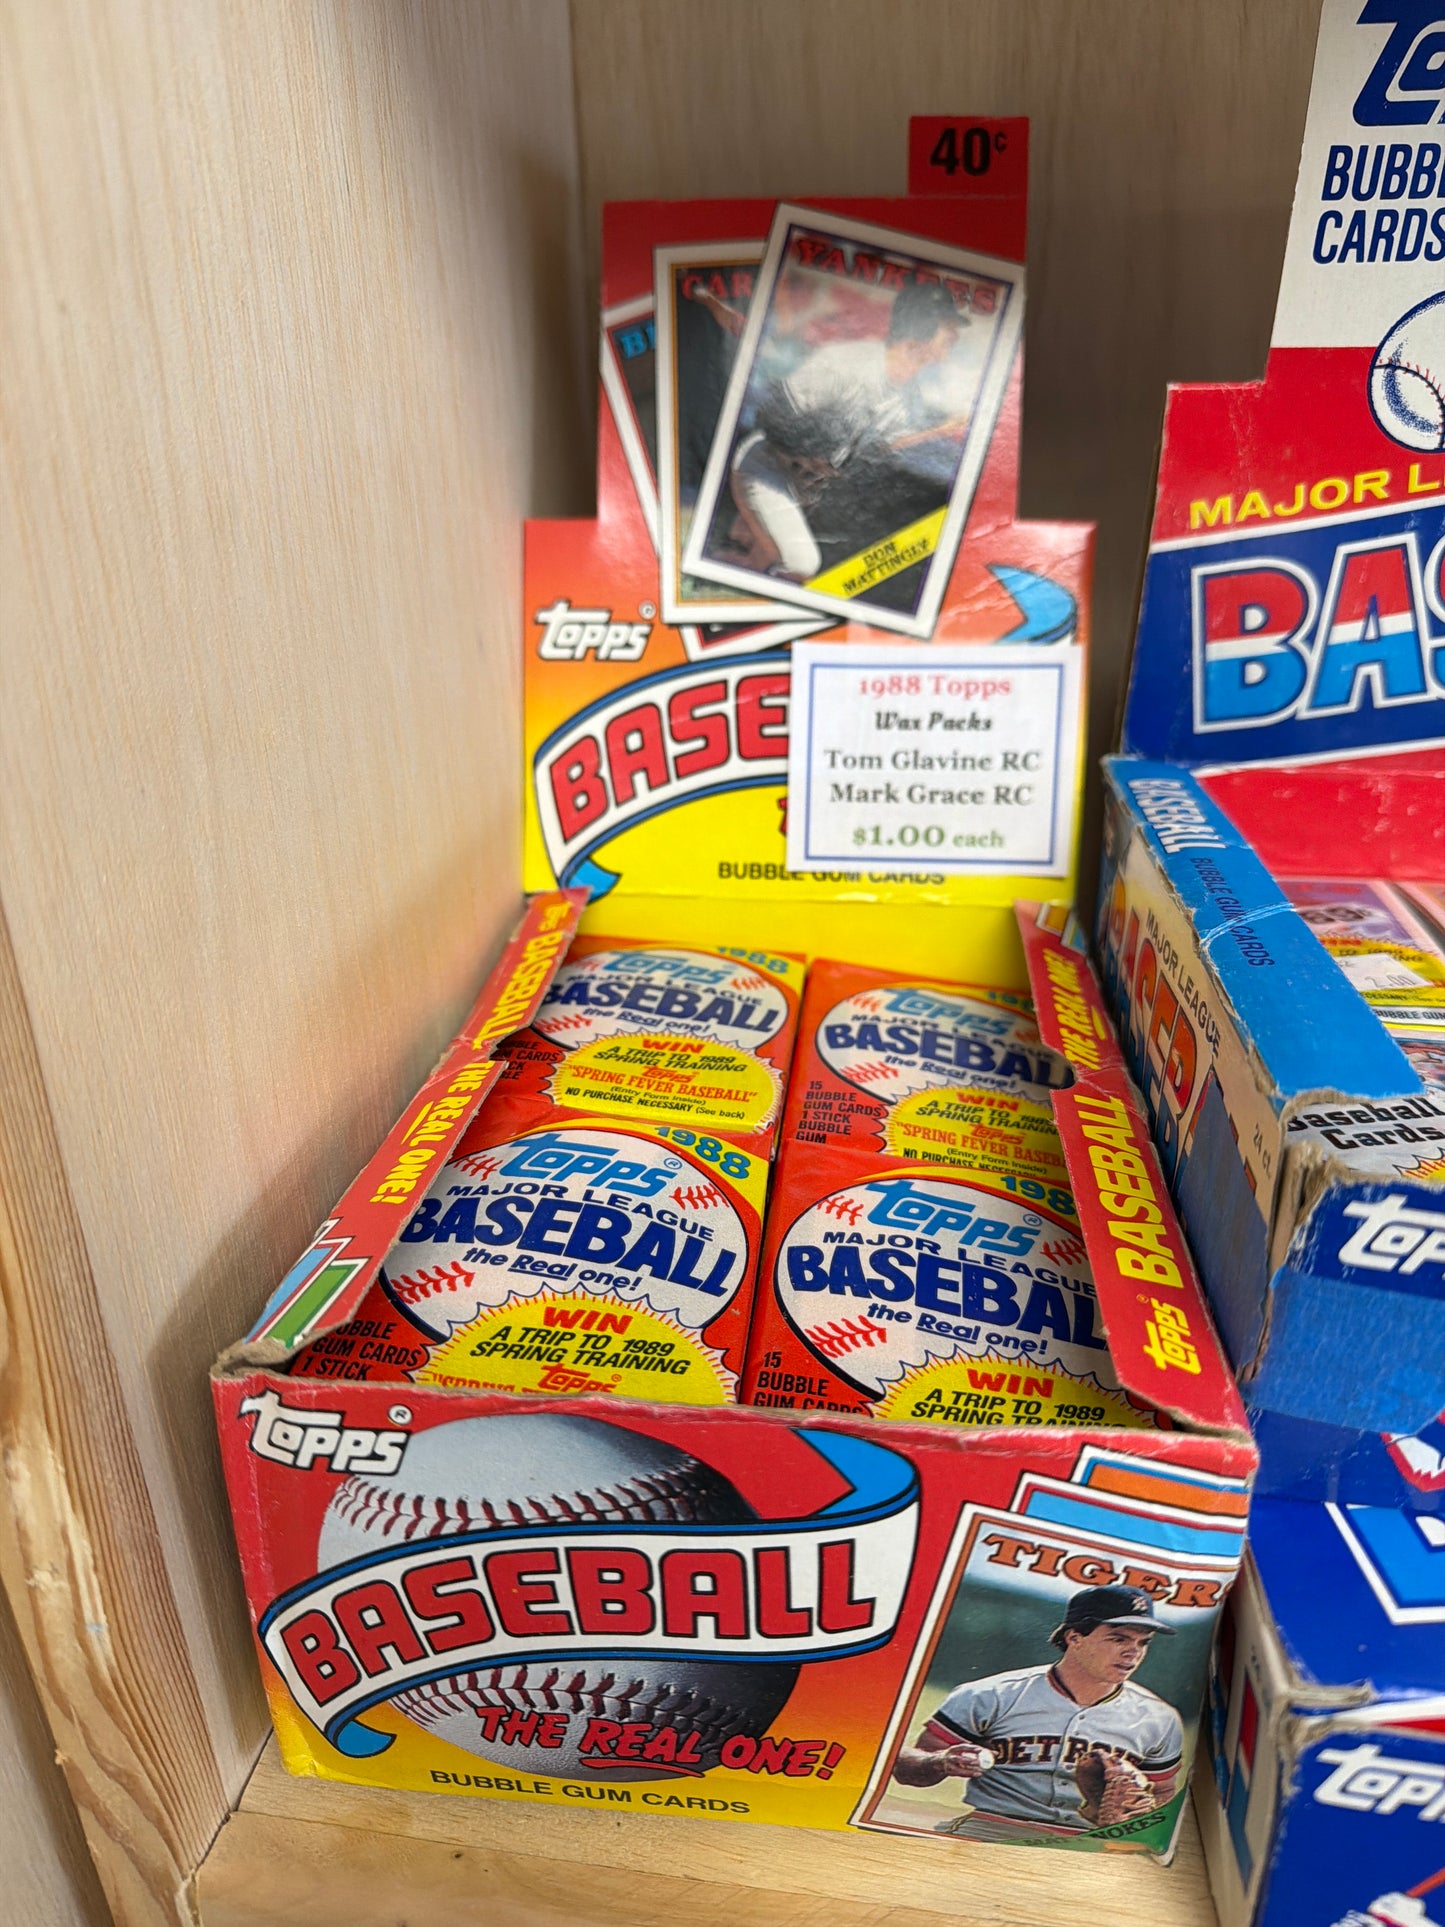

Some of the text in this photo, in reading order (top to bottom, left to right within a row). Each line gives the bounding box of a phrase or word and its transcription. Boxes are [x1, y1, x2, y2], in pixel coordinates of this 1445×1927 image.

[1321, 143, 1445, 201] BUBB
[1189, 470, 1390, 529] MAJOR
[863, 540, 897, 568] DON
[859, 675, 1013, 701] 1988 Topps
[875, 710, 994, 732] Wax Packs
[824, 749, 1043, 772] Tom Glavine RC
[830, 783, 1035, 806] Mark Grace RC
[1128, 778, 1228, 854] BASEBALL
[853, 825, 1006, 848] $1.00 each
[1190, 857, 1233, 894] BUBBLE
[1231, 925, 1276, 967] CARDS
[716, 944, 790, 975] 1988
[473, 931, 563, 1050] BASEBALL
[566, 972, 763, 1006] MAJOR LEAGUE
[1146, 907, 1222, 1058] MAJOR LEAGUE
[582, 1007, 710, 1034] the Real one!
[850, 1013, 940, 1030] MAJOR
[516, 1050, 559, 1062] CARDS
[606, 1045, 621, 1054] A
[622, 1047, 659, 1061] TRIP
[662, 1050, 690, 1063] TO
[642, 1038, 705, 1054] WIN
[1059, 1028, 1102, 1071] THE
[593, 1051, 748, 1073] SPRING TRAINING
[884, 1054, 1017, 1089] the Real one!
[610, 1085, 707, 1106] (Entry Form Inside)
[627, 1074, 674, 1095] FEVER
[806, 1090, 858, 1102] BUBBLE
[809, 1081, 823, 1090] 15
[565, 1086, 746, 1120] NO PURCHASE NECESSARY (See back)
[803, 1101, 882, 1118] GUM CARDS
[942, 1102, 986, 1116] TRIP
[988, 1107, 1011, 1118] TO
[956, 1092, 1020, 1112] WIN
[798, 1120, 852, 1135] BUBBLE
[813, 1111, 851, 1123] STICK
[915, 1106, 1059, 1136] SPRING TRAININ
[370, 1060, 495, 1205] THE REAL ONE!
[795, 1131, 828, 1144] GUM
[961, 1134, 1009, 1157] FEVER
[1320, 1123, 1445, 1150] Cards
[653, 1125, 752, 1180] 1988
[903, 1147, 918, 1158] NO
[1072, 1094, 1185, 1290] BASEBALL
[446, 1181, 716, 1243] MAJOR LEAGUE
[399, 1195, 738, 1298] BASEBALL
[462, 1247, 645, 1292] the Real one!
[822, 1231, 1098, 1297] MAJOR LEAGUE
[786, 1244, 1109, 1352] BASEBAL
[336, 1319, 398, 1341] UBBLE
[542, 1306, 634, 1335] WIN
[867, 1302, 1048, 1356] the Real one!
[311, 1336, 422, 1368] GUM CARDS
[490, 1326, 676, 1358] A TRIP TO 1989
[300, 1355, 373, 1382] 1 STICK
[469, 1341, 692, 1376] SPRING TRAINING
[763, 1350, 782, 1369] 15
[756, 1371, 830, 1398] BUBBLE
[967, 1368, 1055, 1398] WIN
[910, 1401, 1005, 1426] SPRING
[924, 1388, 943, 1403] A
[950, 1391, 1007, 1411] TRIP
[1010, 1399, 1043, 1416] TO
[1053, 1403, 1107, 1422] 1989
[281, 1540, 877, 1703] BASEBALL
[474, 1706, 847, 1781] THE REAL ONE!
[430, 1769, 751, 1815] BUBBLE GUM CARDS
